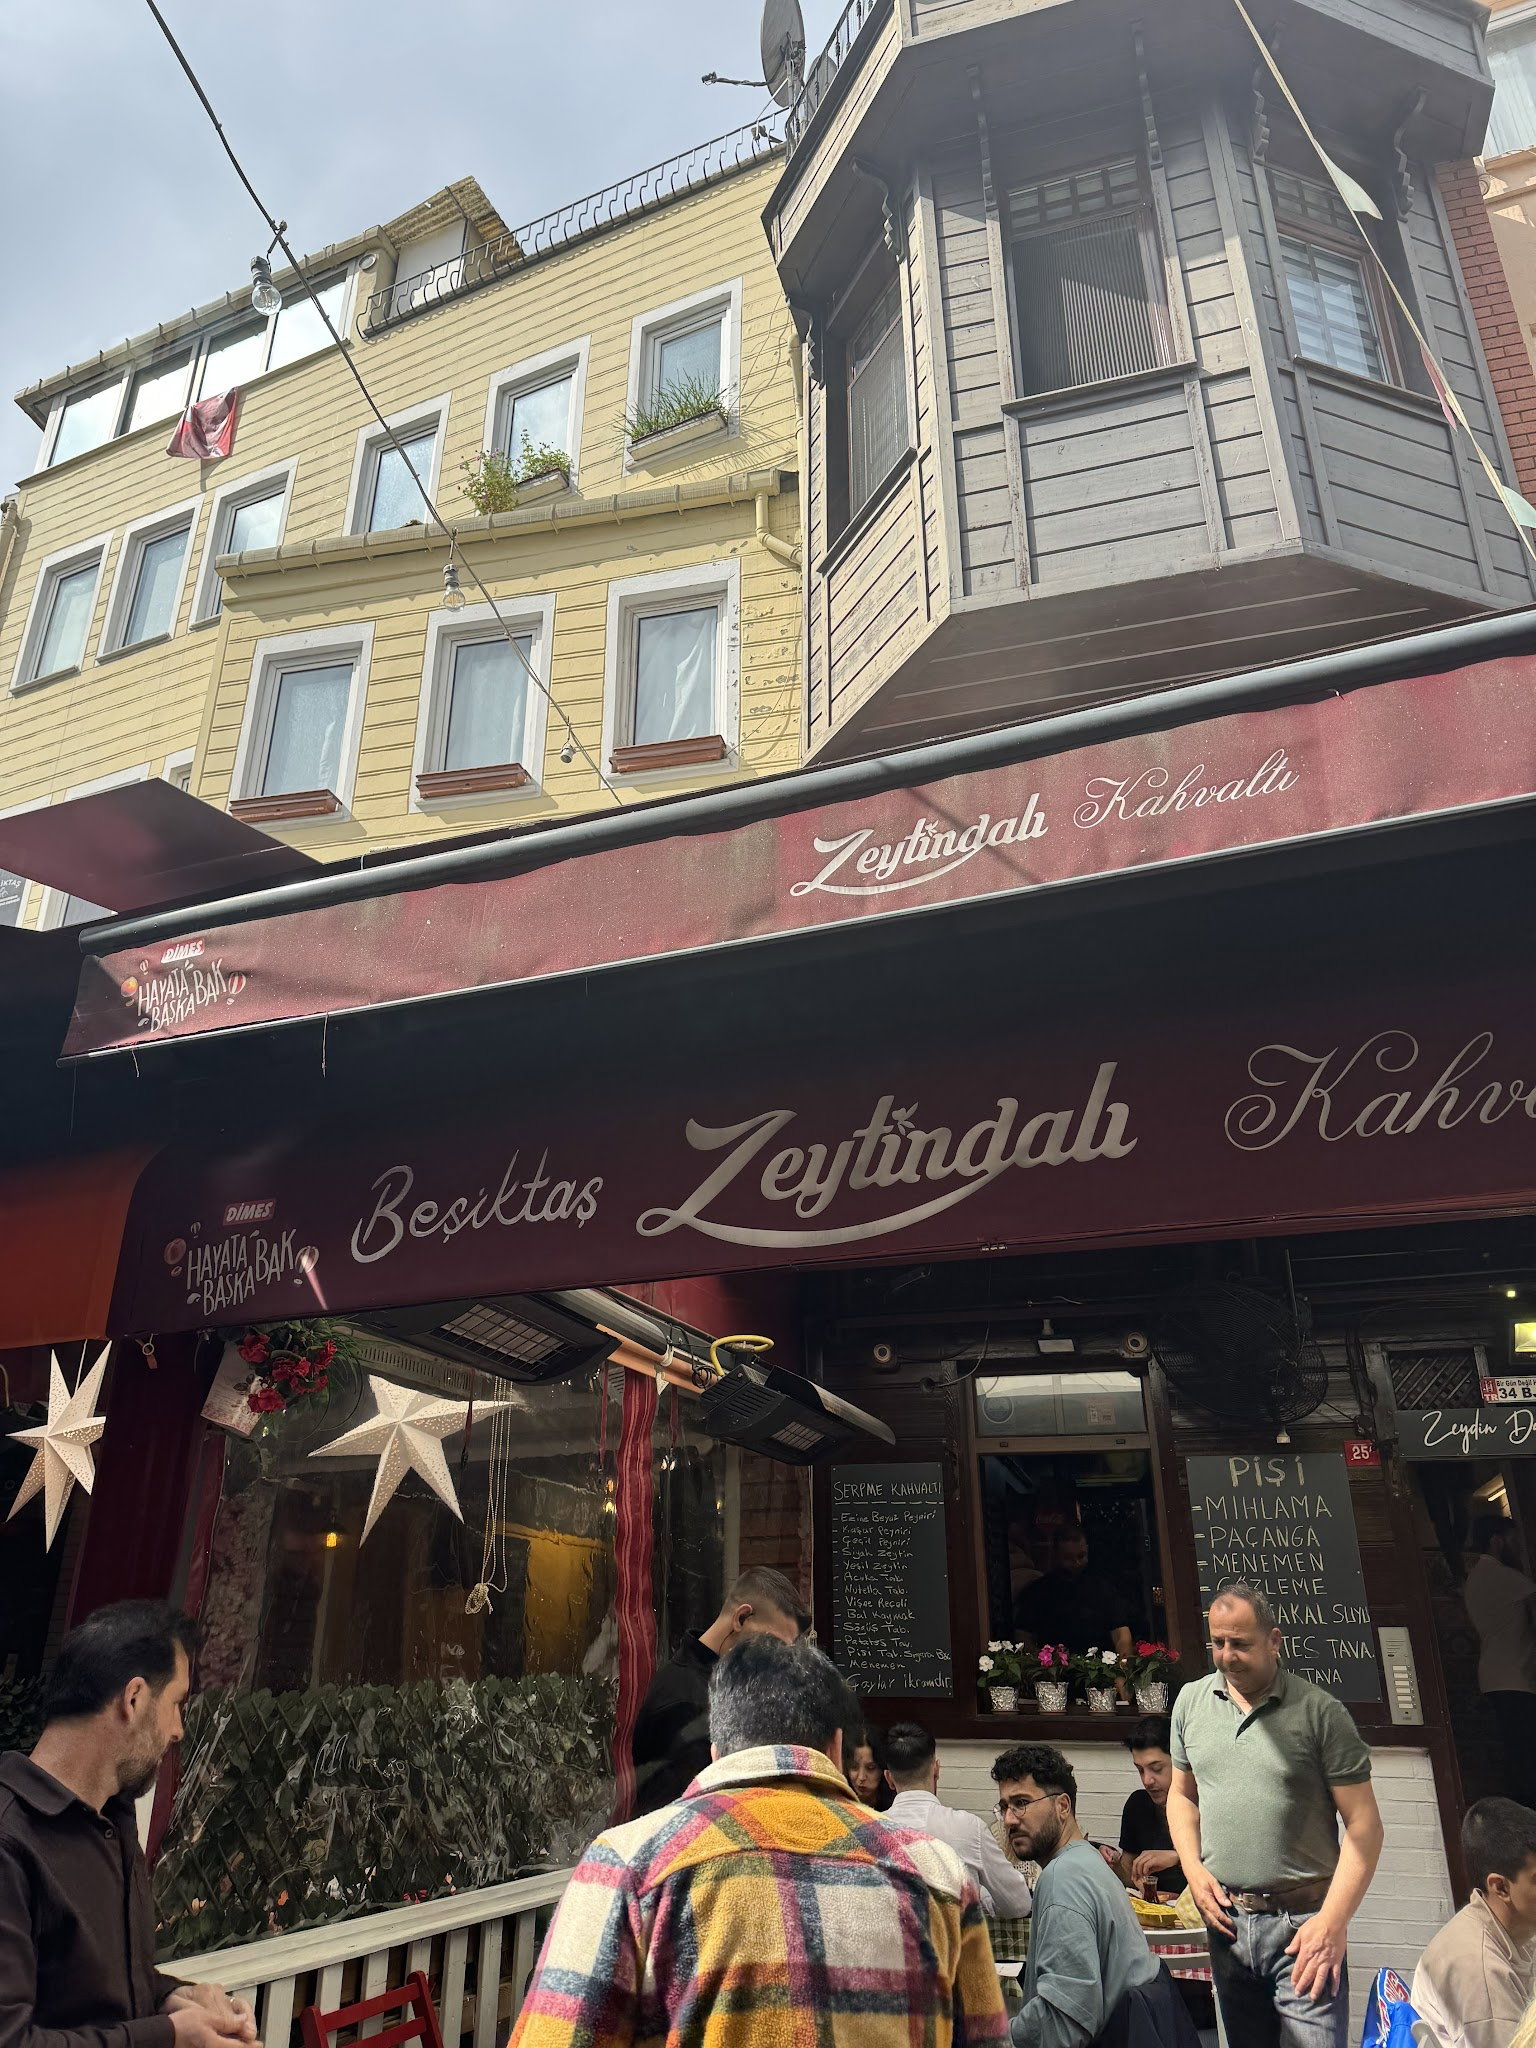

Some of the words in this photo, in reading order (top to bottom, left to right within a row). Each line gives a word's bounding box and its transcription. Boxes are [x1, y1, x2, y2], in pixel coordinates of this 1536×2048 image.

[790, 793, 1048, 896] Zeytindalı
[1073, 748, 1299, 829] Kahvaltı
[165, 940, 203, 960] DİMES
[138, 967, 189, 1016] HAYATA
[193, 958, 227, 1007] BAK
[150, 996, 195, 1033] BAŞKA
[351, 1146, 604, 1264] Beşiktaş
[636, 1061, 1138, 1249] Zeytindalı
[226, 1201, 273, 1222] DİMES
[187, 1233, 248, 1290] HAYATA
[256, 1229, 297, 1285] BAK
[203, 1266, 255, 1316] BAŞKA
[1484, 1393, 1499, 1401] TR
[1498, 1387, 1517, 1399] 34
[1421, 1408, 1498, 1454] Zeydin
[1228, 1456, 1305, 1488] PİŞİ
[834, 1480, 883, 1501] SERPME
[891, 1482, 942, 1497] KAHVALTI
[1205, 1495, 1332, 1521] MIHLAMA
[1210, 1525, 1321, 1549] PAÇANGA
[1212, 1552, 1324, 1574] MENEMEN
[844, 1584, 882, 1596] Nutella
[847, 1608, 868, 1620] Bal
[849, 1659, 906, 1670] Menemen
[1300, 1667, 1344, 1685] TAVA
